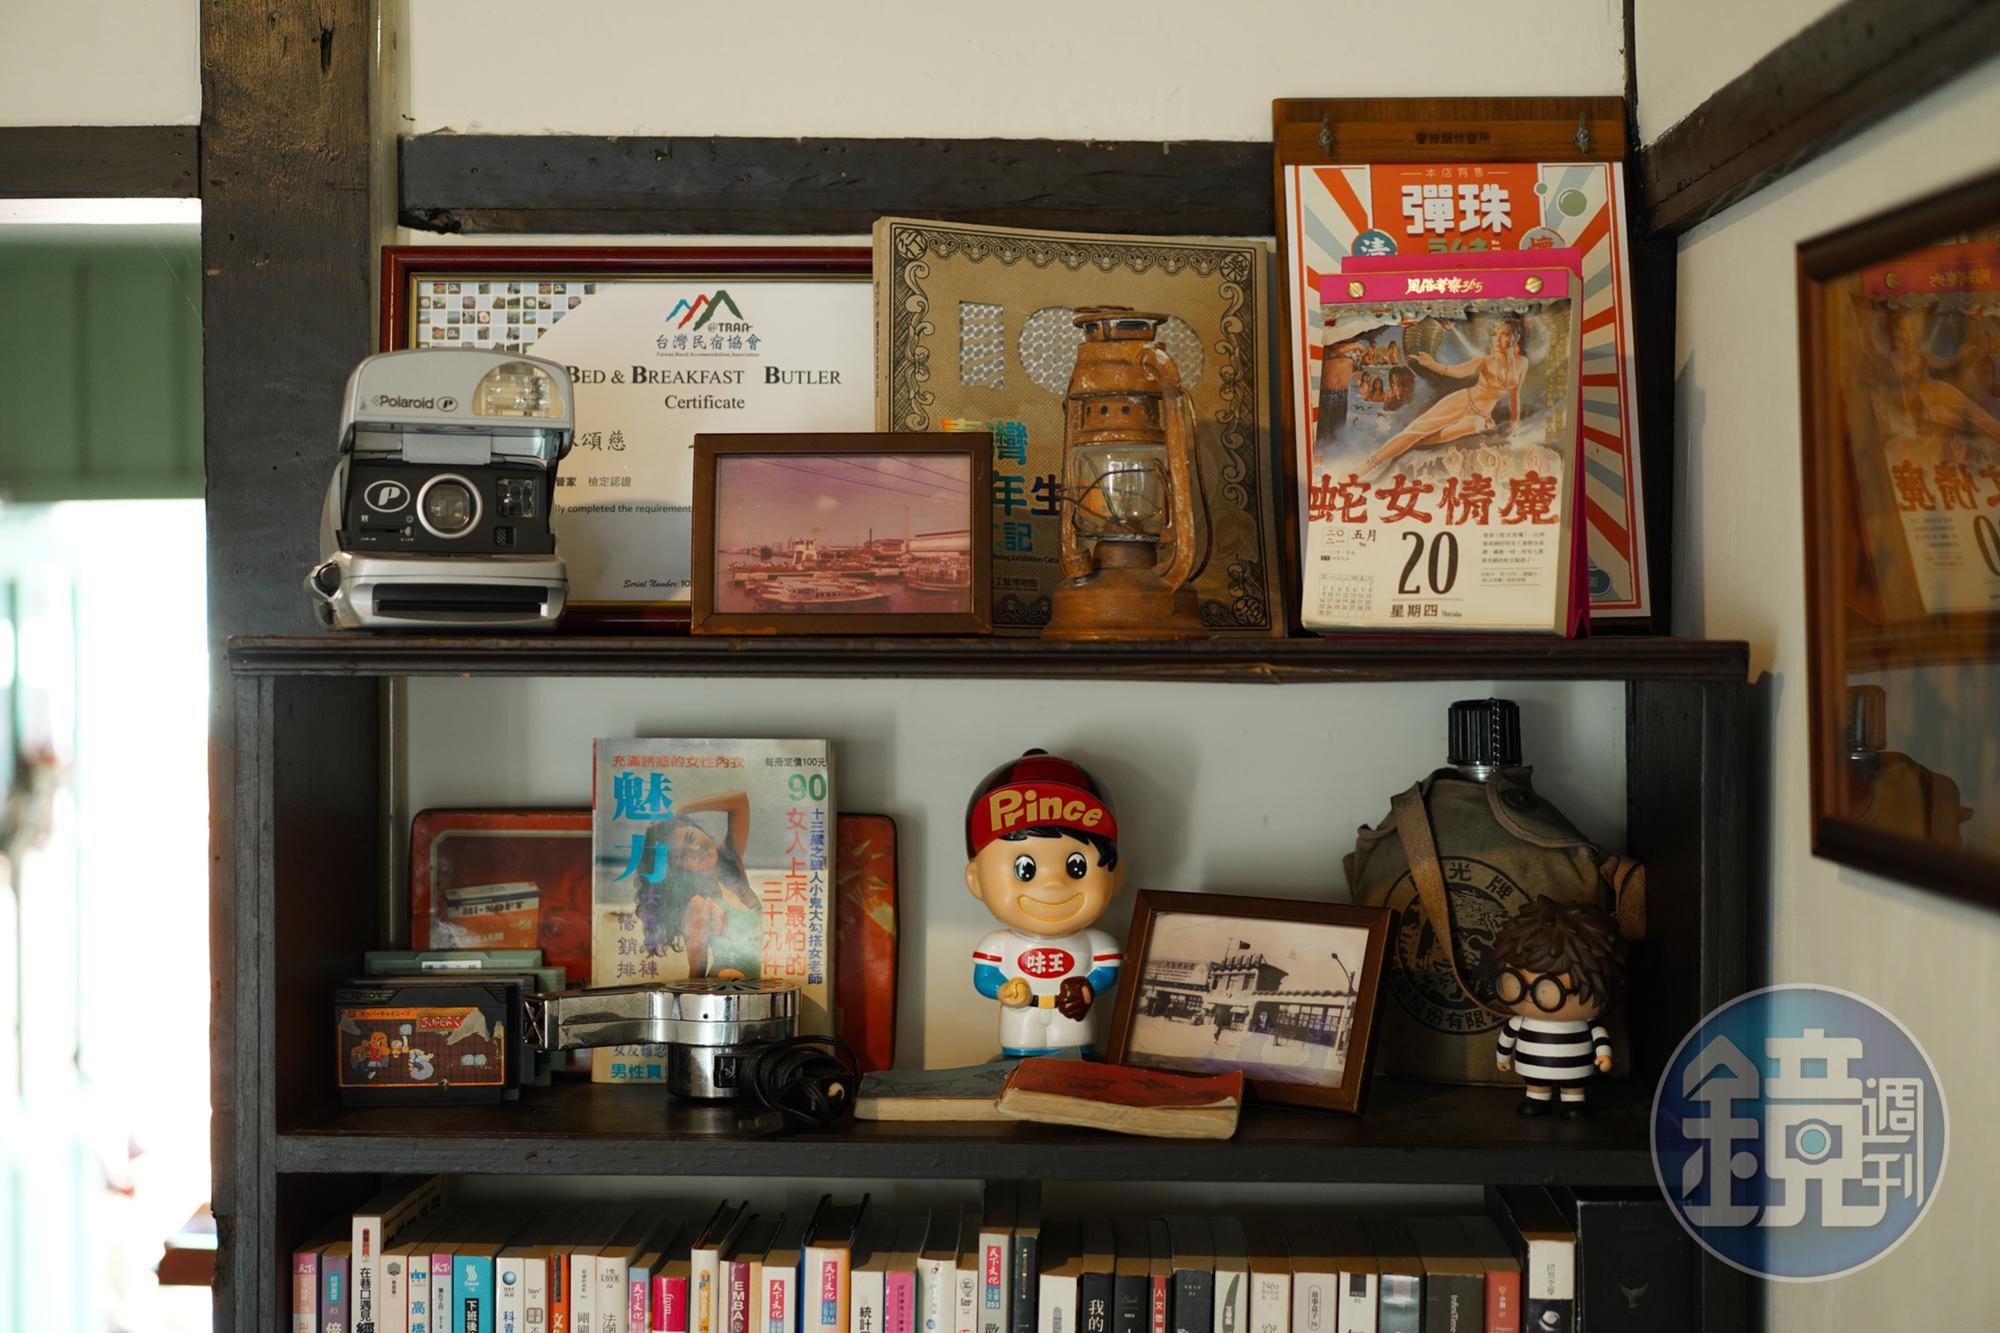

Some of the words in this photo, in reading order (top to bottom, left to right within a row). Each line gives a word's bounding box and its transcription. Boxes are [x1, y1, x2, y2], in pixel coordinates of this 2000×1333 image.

[1425, 167, 1484, 178] 本店有售
[1401, 183, 1513, 235] 彈珠
[655, 334, 762, 351] 台灣民宿協會
[610, 370, 625, 385] &
[631, 365, 745, 385] BREAKFAST
[764, 365, 842, 385] BUTLER
[380, 395, 434, 410] Polaroid
[664, 394, 745, 410] Certificate
[572, 430, 627, 452] 頌慈
[567, 504, 616, 514] completed
[618, 504, 633, 513] the
[1308, 471, 1562, 526] 蛇女情魔
[993, 522, 1034, 553] 記
[1351, 529, 1377, 543] 五月
[1397, 531, 1459, 595] 20
[623, 579, 647, 589] Serial
[1390, 603, 1439, 618] 星期四
[787, 773, 828, 802] 90
[988, 789, 1103, 832] Prince
[611, 771, 674, 885] 魅力
[785, 807, 809, 977] 女人上床最怕的
[616, 911, 637, 980] 暢銷排
[1025, 953, 1065, 973] 味王
[824, 1263, 836, 1301] 天下文化
[988, 1248, 1000, 1285] 天下文化
[632, 1283, 644, 1321] 天下文化
[733, 1281, 745, 1321] EMBA
[771, 1281, 783, 1319] 天下文化
[1088, 1299, 1105, 1331] 我的
[859, 1306, 872, 1333] 統計
